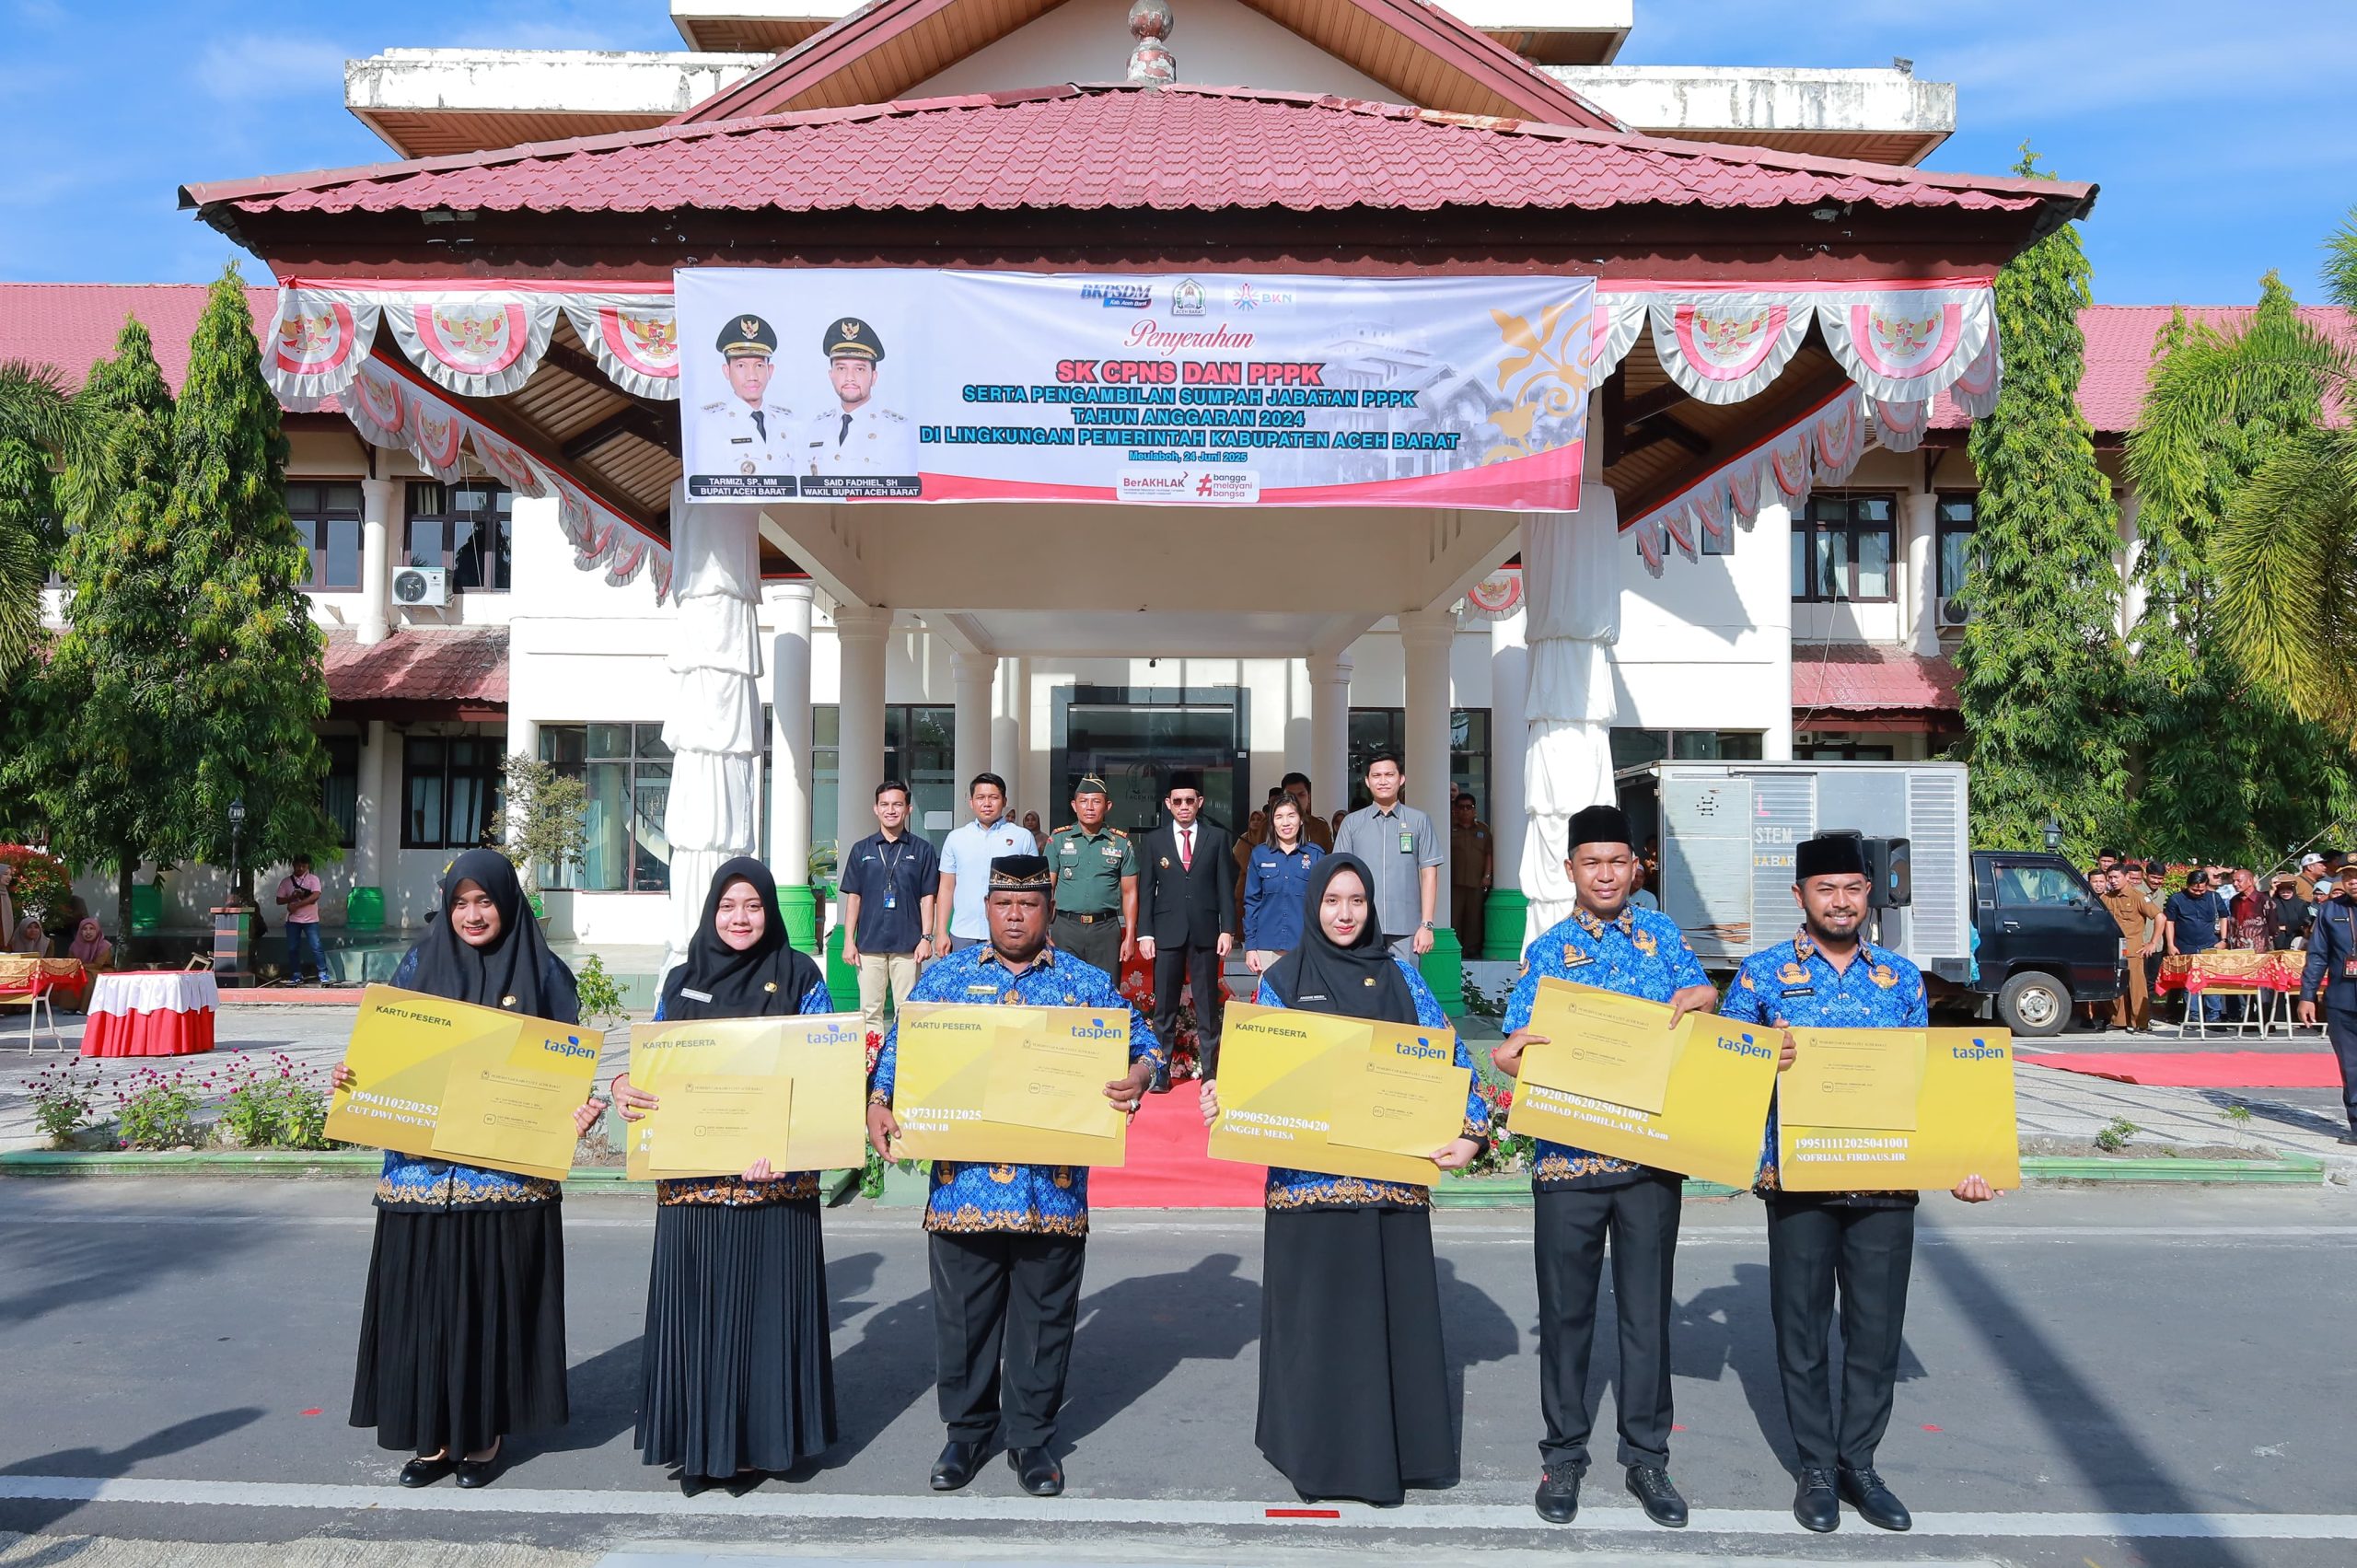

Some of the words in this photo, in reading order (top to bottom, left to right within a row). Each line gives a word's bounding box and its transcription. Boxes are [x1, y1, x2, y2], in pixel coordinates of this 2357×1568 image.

[1081, 285, 1154, 299] BKPSDM
[1262, 294, 1292, 303] BKN
[1124, 319, 1255, 356] Penyerahan
[1056, 360, 1099, 384] SK
[1101, 360, 1178, 384] CPNS
[1182, 361, 1242, 385] DAN
[1248, 362, 1326, 386] PPPK
[963, 385, 1028, 403] SERTA
[1030, 385, 1176, 405] PENGAMBILAN
[1178, 388, 1262, 406] SUMPAH
[1267, 389, 1360, 407] JABATAN
[1362, 389, 1421, 409] PPPK
[1071, 407, 1139, 425] TAHUN
[1141, 408, 1256, 427] ANGGARAN
[1259, 410, 1306, 428] 2024
[920, 425, 939, 443] DI
[945, 426, 1075, 446] LINGKUNGAN
[1079, 428, 1205, 447] PEMERINTAH
[1210, 429, 1330, 448] KABUPATEN
[1332, 432, 1388, 449] ACEH
[1391, 432, 1461, 451] BARAT
[1129, 450, 1181, 462] Meulaboh,
[1183, 452, 1197, 462] 24
[1198, 451, 1221, 462] Juni
[1223, 452, 1248, 462] 2025
[709, 478, 745, 487] TARMIZI,
[747, 478, 761, 486] SP.,
[763, 478, 777, 486] MM
[845, 479, 884, 488] FADHIEL,
[1123, 477, 1185, 488] BerAKHLAK
[1213, 474, 1247, 482] bangga
[804, 488, 831, 496] WAKIL
[832, 488, 863, 496] BUPATI
[864, 488, 889, 496] ACEH
[1213, 482, 1252, 492] melayani
[1213, 490, 1245, 499] bangsa
[1757, 795, 1770, 816] L
[1755, 827, 1792, 843] STEM
[376, 1005, 409, 1018] KARTU
[411, 1012, 452, 1028] PESERTA
[911, 1021, 941, 1030] KARTU
[943, 1022, 981, 1031] PESERTA
[1071, 1025, 1121, 1040] taspen
[1236, 1023, 1266, 1033] KARTU
[1267, 1028, 1307, 1039] PESERTA
[643, 1040, 673, 1050] KARTU
[675, 1039, 716, 1048] PESERTA
[807, 1029, 858, 1046] taspen
[544, 1037, 596, 1060] taspen
[1396, 1041, 1446, 1061] taspen
[1717, 1035, 1771, 1059] taspen
[1953, 1045, 2004, 1061] taspen
[346, 1104, 370, 1116] CUT
[370, 1109, 393, 1121] DWI
[1525, 1099, 1572, 1116] RAHMAD
[1637, 1125, 1645, 1135] S.
[1648, 1128, 1669, 1142] Kom
[903, 1121, 935, 1131] MURNI
[939, 1123, 948, 1132] IB
[1223, 1123, 1261, 1136] ANGGIE
[1263, 1129, 1295, 1141] MEISA
[1795, 1138, 1909, 1149] 199511112025041001
[1796, 1153, 1844, 1162] NOFRIJAL
[1846, 1153, 1906, 1162] FIRDAUS.HR
